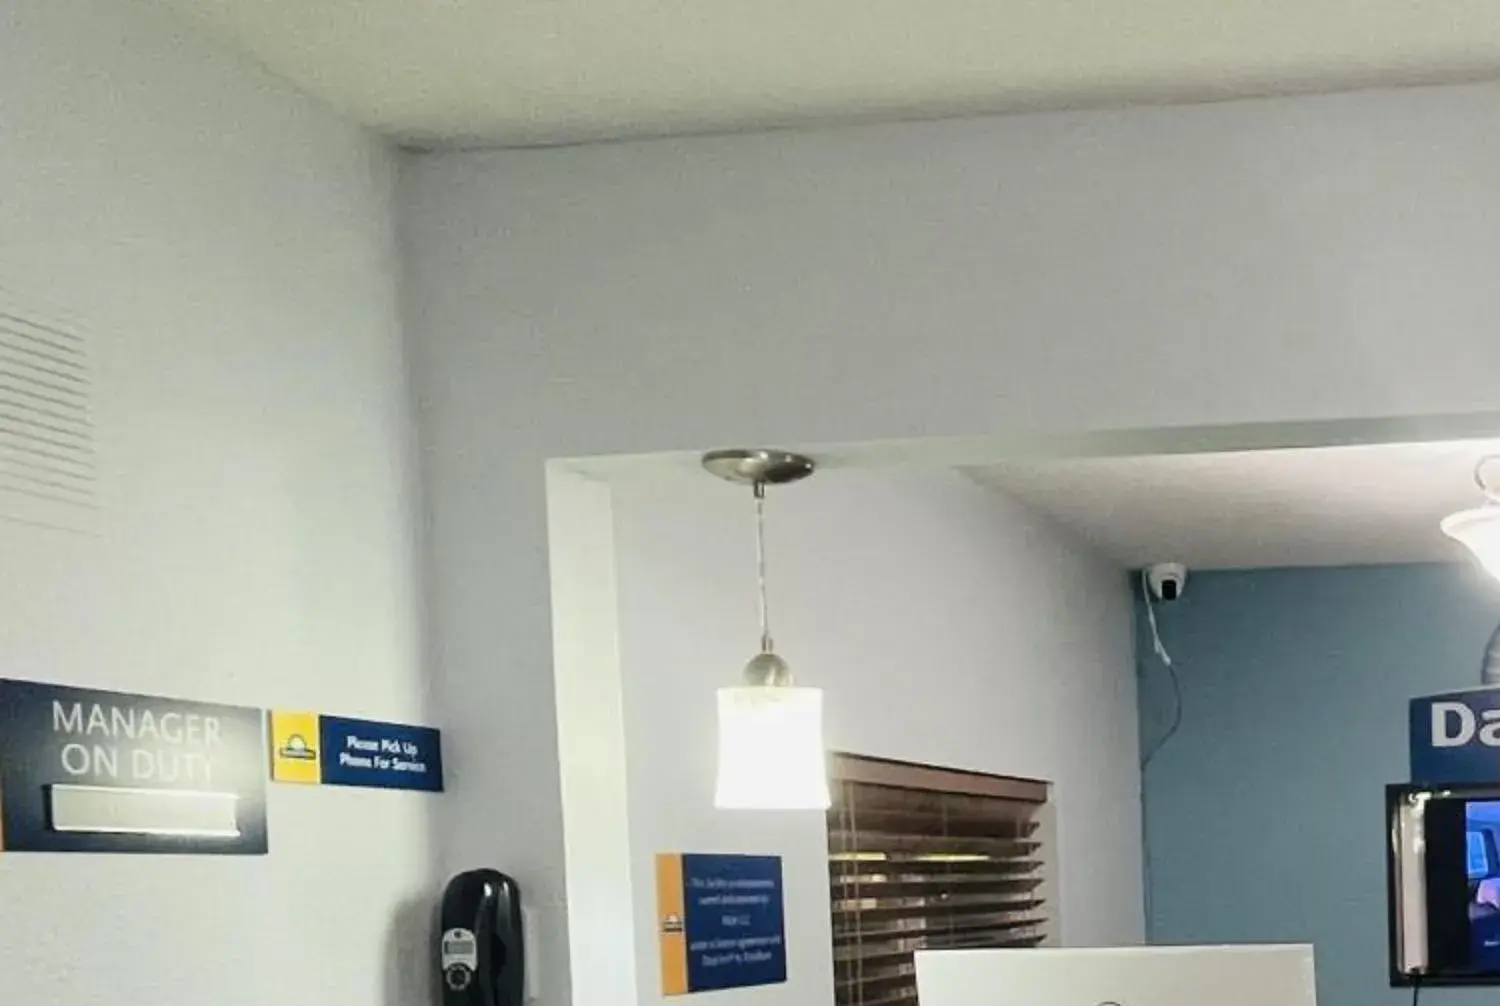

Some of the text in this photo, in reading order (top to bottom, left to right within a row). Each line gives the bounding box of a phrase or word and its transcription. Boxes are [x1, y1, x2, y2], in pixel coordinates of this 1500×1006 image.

[52, 700, 222, 746] MANAGER
[61, 743, 213, 784] ON DUTY
